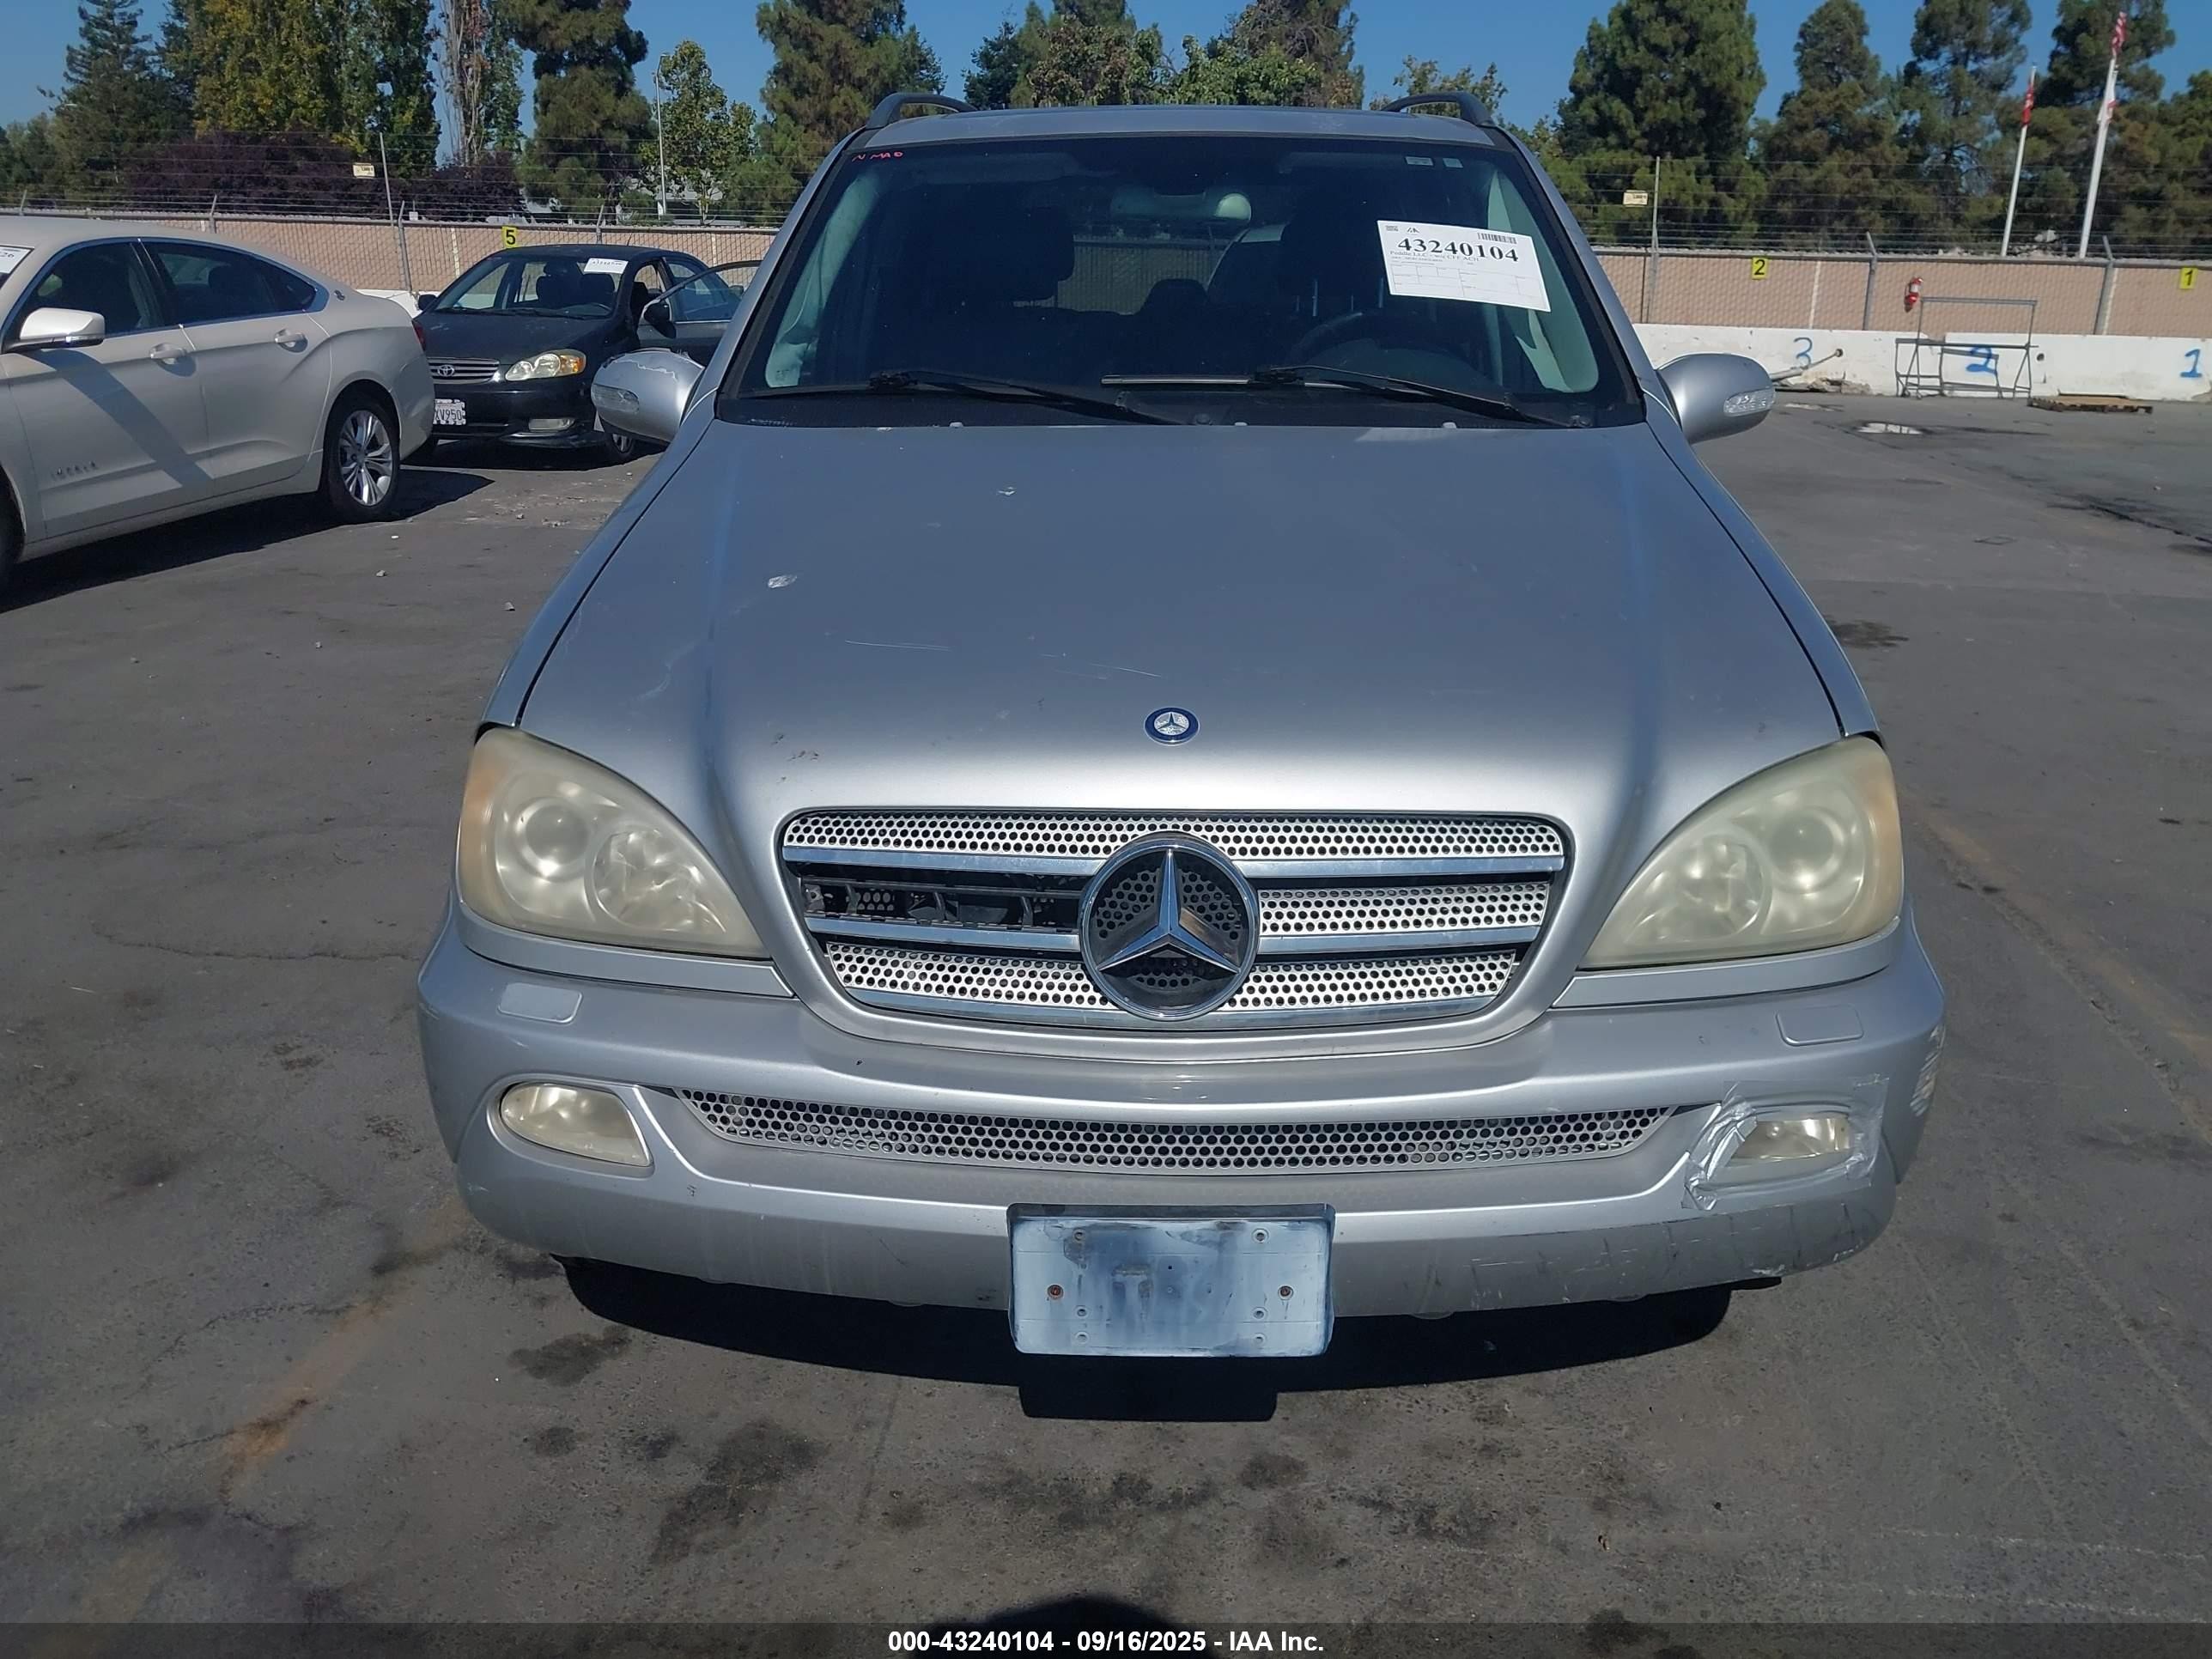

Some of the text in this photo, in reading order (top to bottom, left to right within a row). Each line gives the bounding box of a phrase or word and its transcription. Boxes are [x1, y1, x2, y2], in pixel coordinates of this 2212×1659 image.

[506, 229, 516, 245] 5
[1398, 238, 1519, 262] 43240104
[1754, 258, 1765, 276] 2
[2185, 270, 2193, 286] 1
[1794, 337, 1813, 368] 3
[2180, 349, 2203, 378] 1
